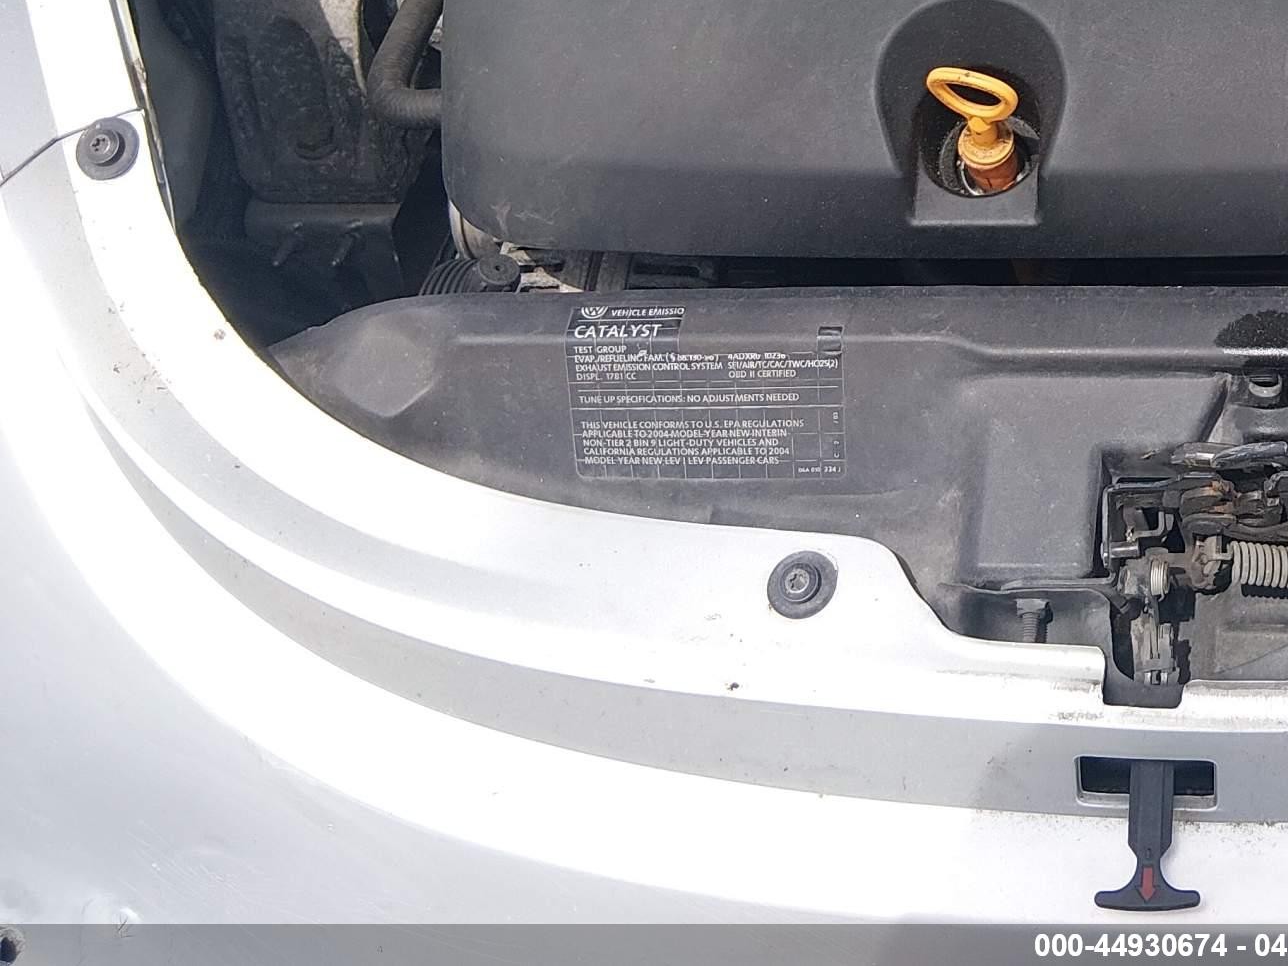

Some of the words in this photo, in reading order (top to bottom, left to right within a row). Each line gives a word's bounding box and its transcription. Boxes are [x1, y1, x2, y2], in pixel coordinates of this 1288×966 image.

[611, 308, 647, 317] VEHICLE
[574, 323, 662, 339] CATALYST
[574, 345, 593, 354] TEST
[596, 345, 627, 354] GROUP
[575, 363, 612, 372] EXHAUST
[613, 362, 651, 371] EMISSION
[652, 362, 691, 371] CONTROL
[692, 361, 723, 370] SYSTEM
[757, 369, 797, 378] CERTIFIED
[579, 395, 602, 404] TUNE
[603, 395, 616, 403] UP
[687, 394, 701, 403] NO
[702, 393, 765, 403] ADJUSTMENTS
[766, 393, 800, 402] NEEDED
[581, 421, 601, 429] THIS
[602, 421, 638, 429] VEHICLE
[638, 420, 690, 429] CONFORMS
[691, 420, 704, 429] TO
[723, 420, 741, 428] EPA
[742, 419, 805, 428] REGULATIONS
[582, 429, 631, 438] APPLICABLE
[633, 429, 647, 438] TO
[671, 429, 701, 438] MODEL
[704, 429, 729, 438] YEAR
[729, 429, 750, 437] NEW
[626, 438, 632, 446] 2
[633, 438, 649, 447] BIN
[658, 439, 714, 447] LIGHT-DUTY
[716, 438, 757, 447] VEHICLES
[758, 438, 779, 446] AND
[583, 447, 636, 456] CALIFORNIA
[637, 447, 700, 456] REGULATIONS
[701, 447, 753, 455] APPLICABLE
[754, 447, 767, 455] TO
[769, 447, 790, 455] 2004
[584, 456, 615, 465] MODEL
[617, 456, 640, 465] YEAR
[641, 456, 663, 465] NEW
[705, 456, 755, 465] PASSENGER
[756, 456, 780, 465] CARS
